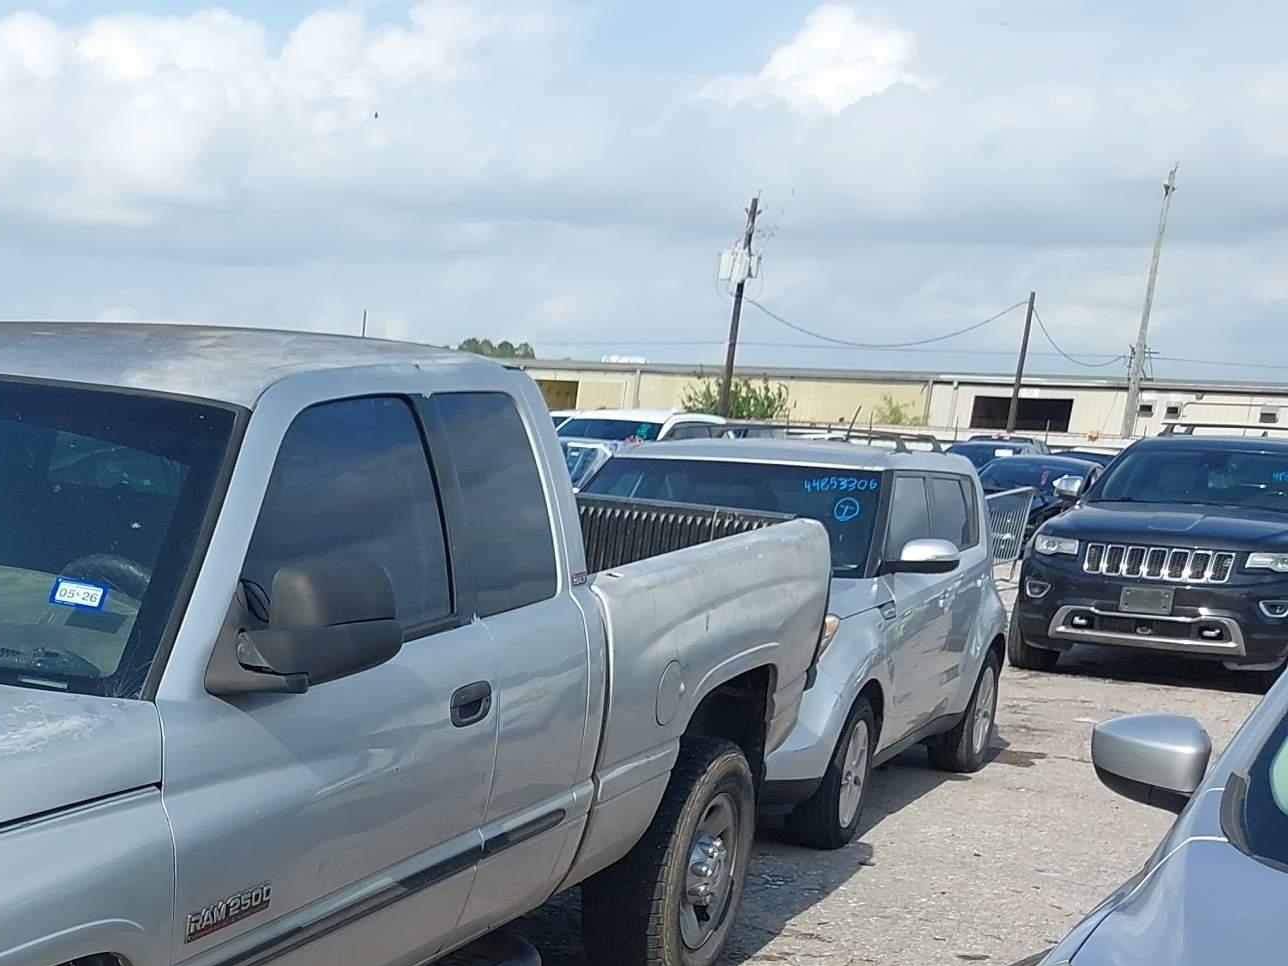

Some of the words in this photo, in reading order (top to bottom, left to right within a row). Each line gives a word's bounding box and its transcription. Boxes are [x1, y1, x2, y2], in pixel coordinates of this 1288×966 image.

[59, 588, 75, 599] 05
[82, 591, 99, 603] 26
[185, 901, 227, 937] RAM
[226, 883, 273, 916] 2500
